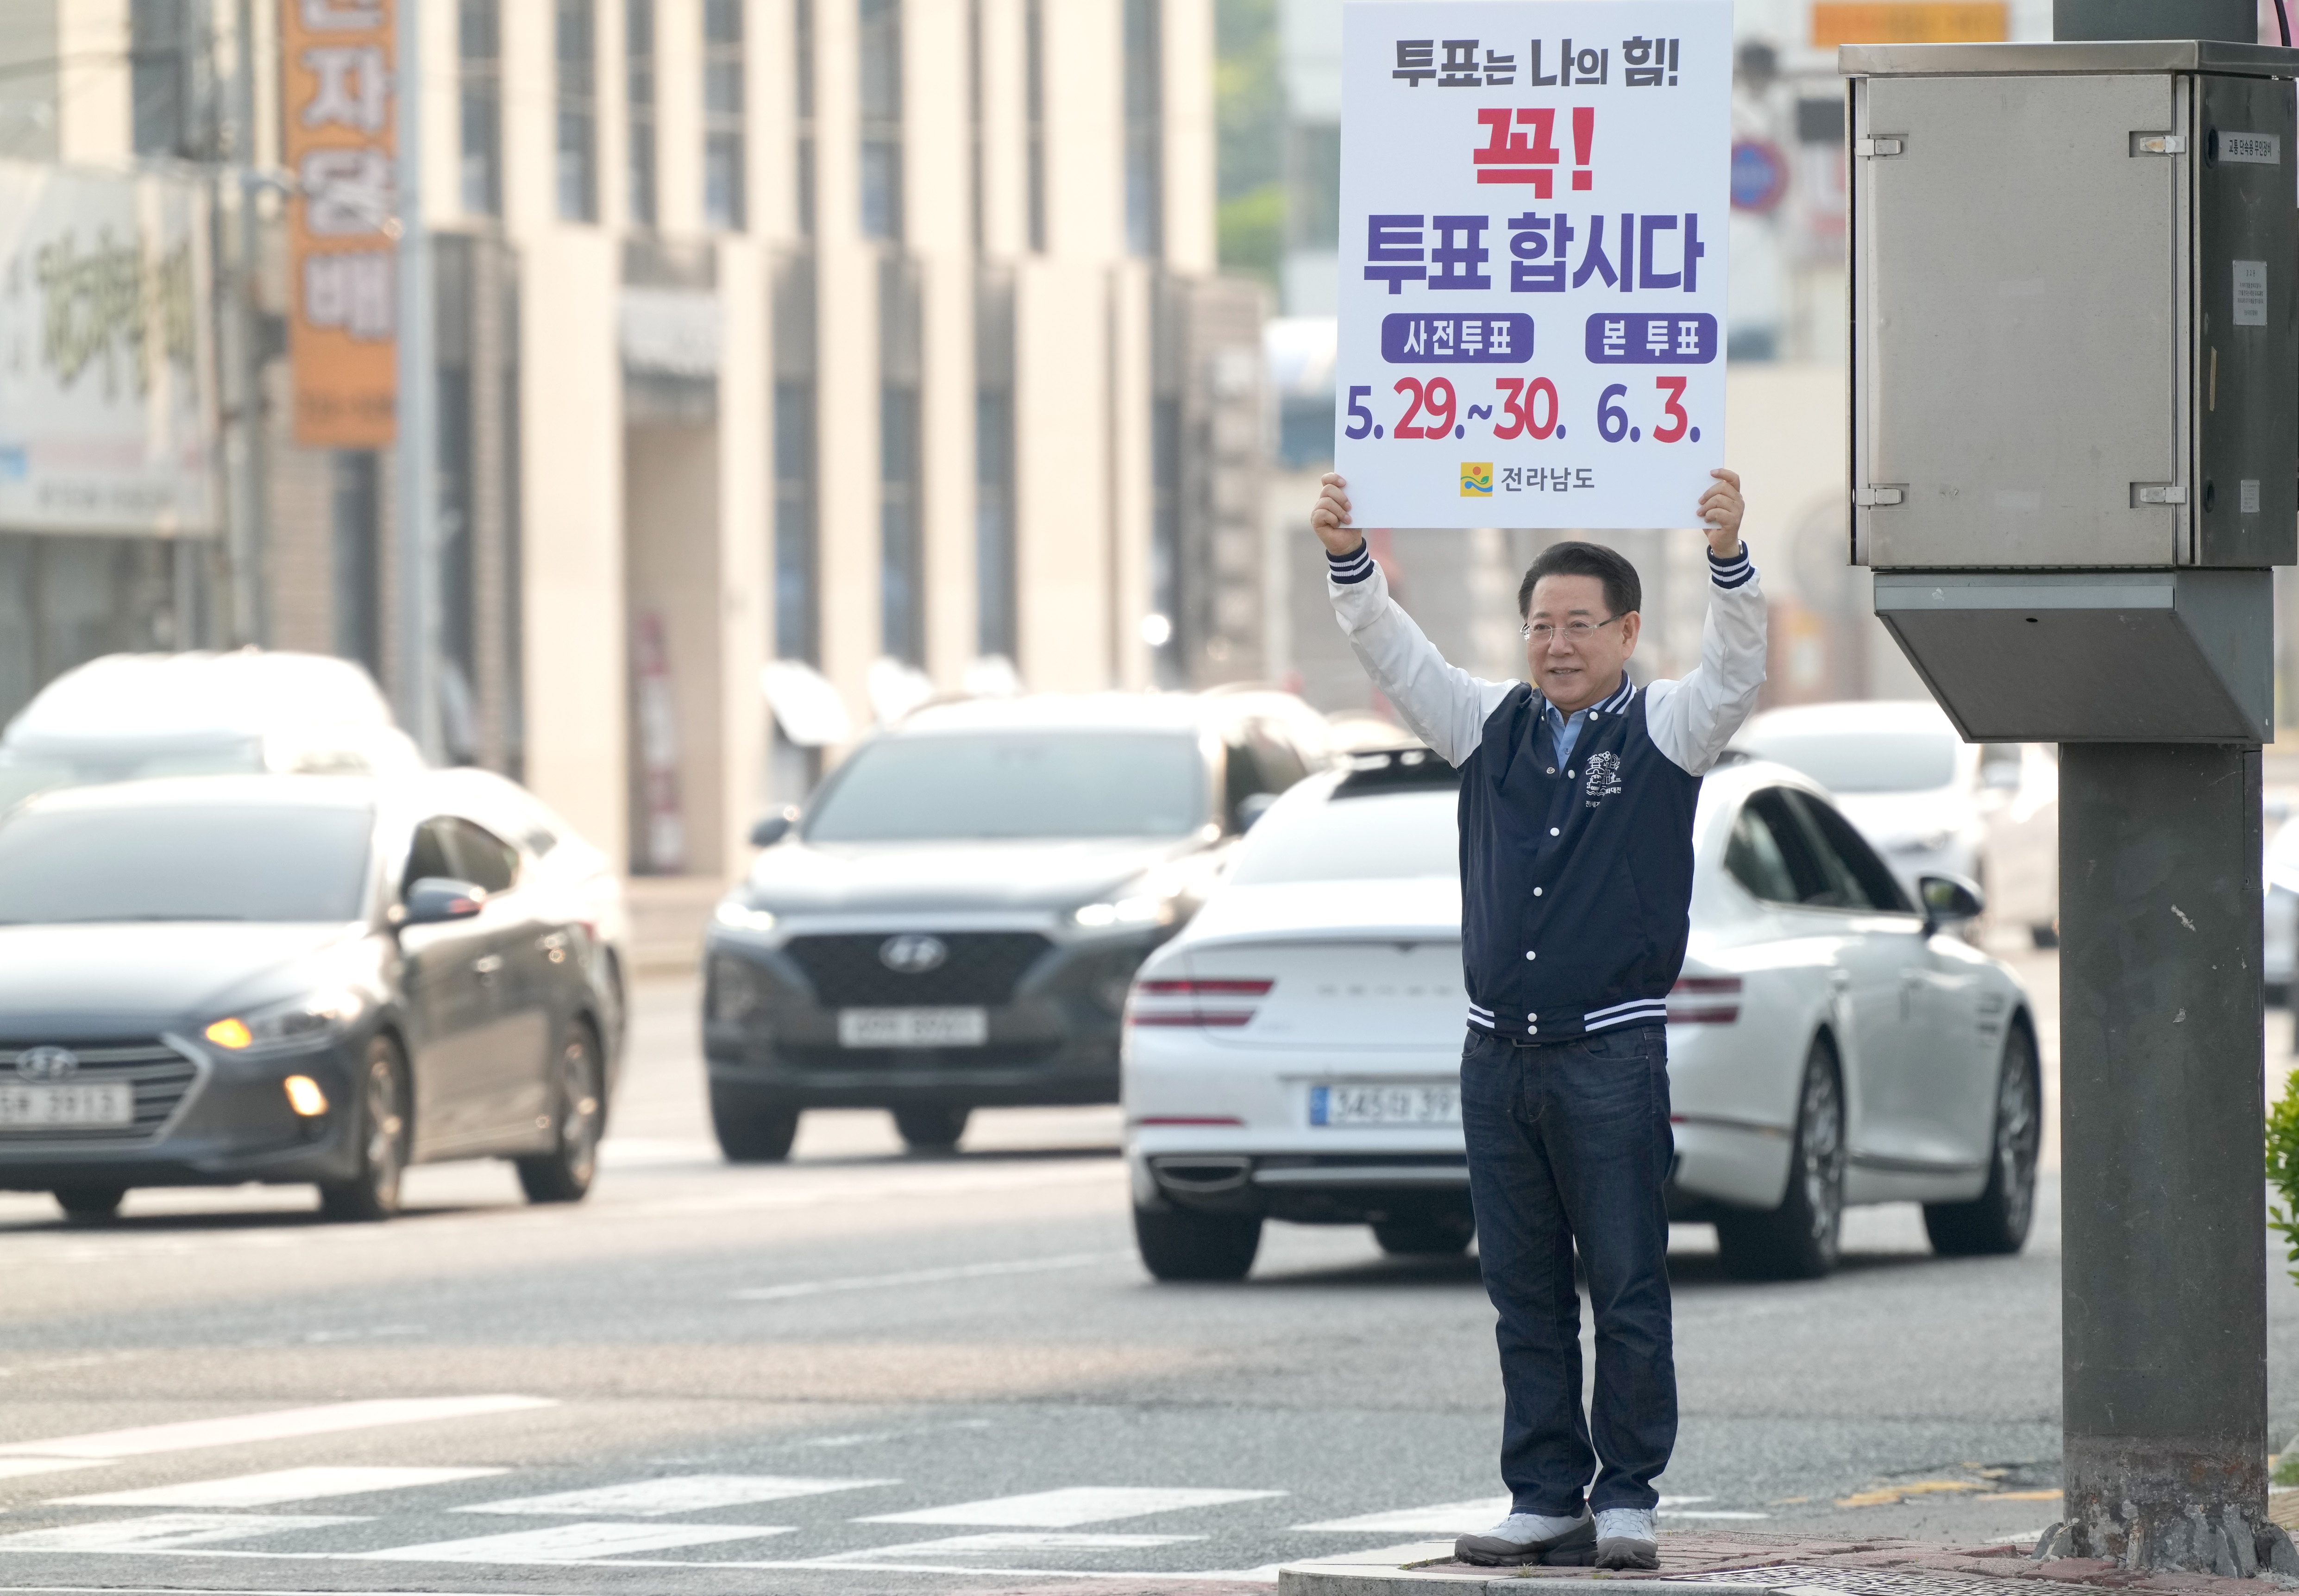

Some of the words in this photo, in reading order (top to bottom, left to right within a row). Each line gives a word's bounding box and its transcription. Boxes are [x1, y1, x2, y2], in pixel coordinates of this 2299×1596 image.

[1392, 39, 1517, 87] 투표는
[1531, 38, 1608, 87] 나의
[1622, 36, 1679, 87] 힘!
[1473, 107, 1594, 199] 꼭!
[2229, 139, 2238, 155] 교통
[2240, 139, 2254, 156] 단속용
[2255, 140, 2271, 157] 무인장비
[1364, 214, 1491, 295] 투표
[1508, 212, 1704, 293] 합시다
[1404, 320, 1511, 356] 사전투표
[1603, 320, 1626, 355] 본
[1646, 320, 1699, 356] 투표
[1344, 385, 1384, 440] 5.
[1597, 383, 1640, 443] 6.
[1653, 376, 1701, 443] 3.
[1501, 467, 1595, 492] 전라남도
